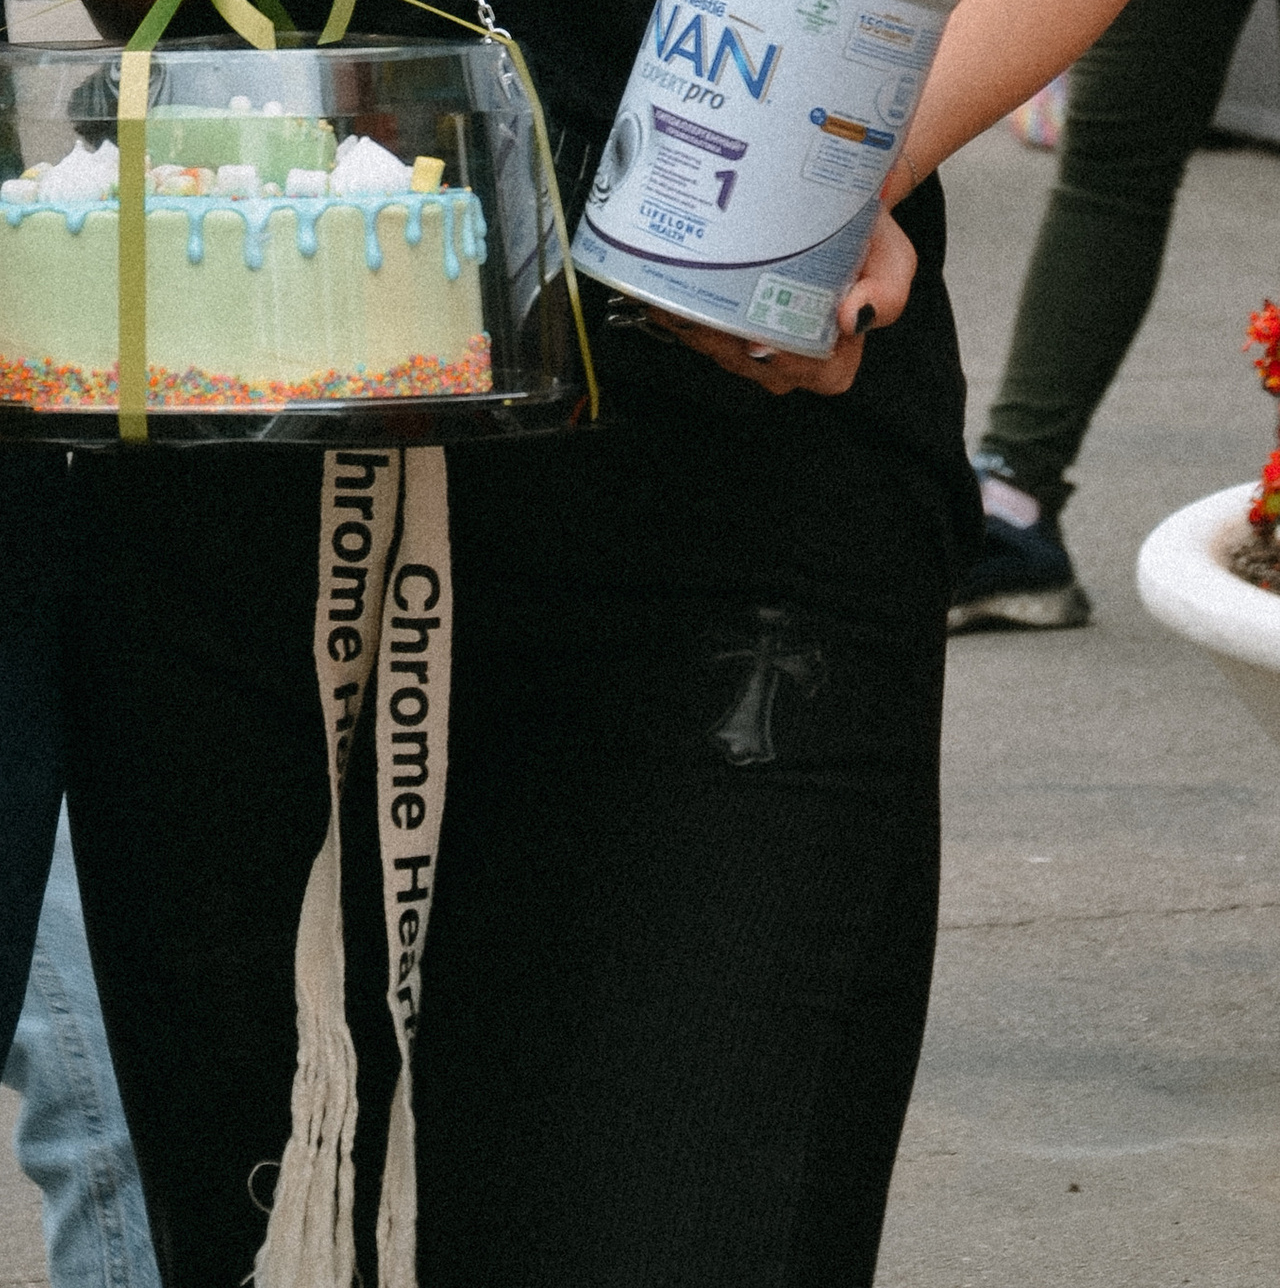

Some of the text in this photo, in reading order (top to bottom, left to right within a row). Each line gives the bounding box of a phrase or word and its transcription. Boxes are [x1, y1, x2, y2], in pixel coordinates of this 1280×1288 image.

[639, 203, 705, 240] LIFELONG
[714, 169, 738, 213] 1
[327, 451, 389, 663] hrome
[389, 563, 441, 831] Chrome
